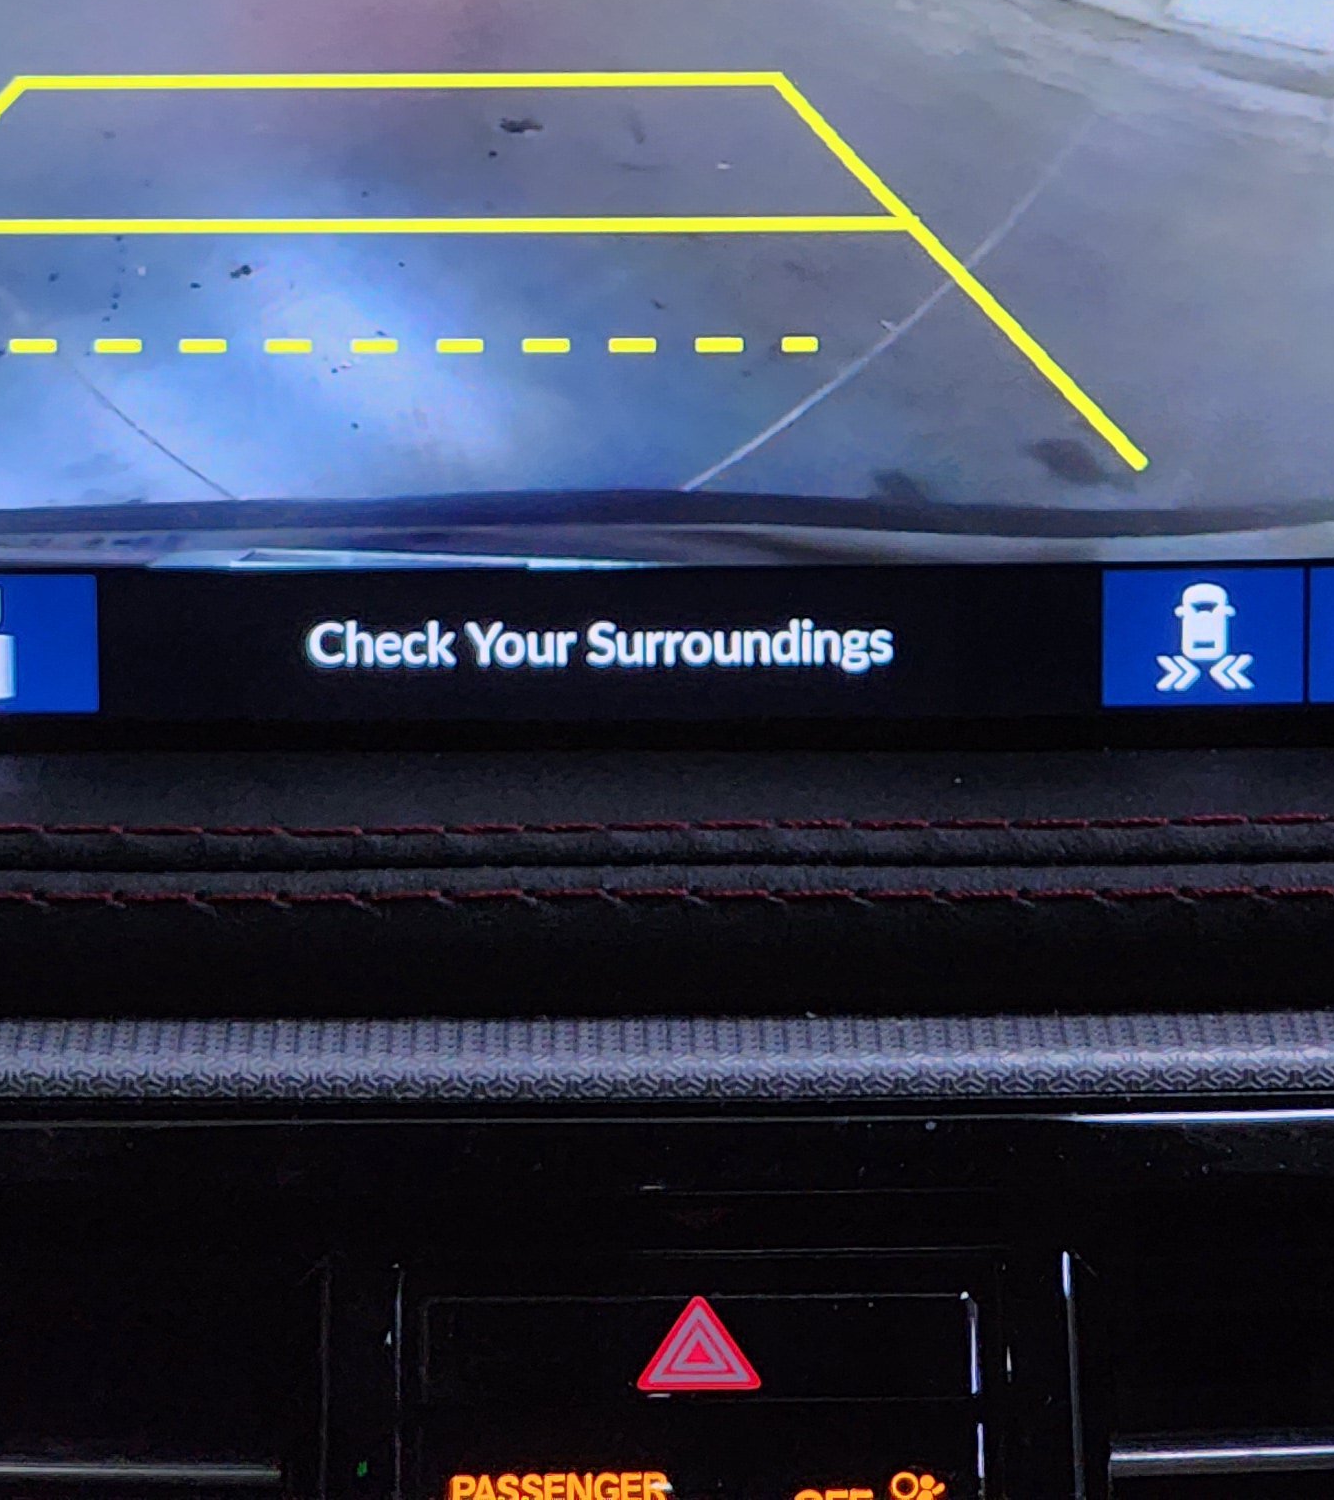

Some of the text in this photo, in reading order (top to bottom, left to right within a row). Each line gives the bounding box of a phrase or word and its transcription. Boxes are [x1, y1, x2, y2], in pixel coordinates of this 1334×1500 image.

[307, 618, 895, 674] Check Your Surroundings
[449, 1471, 669, 1500] PASSENGER
